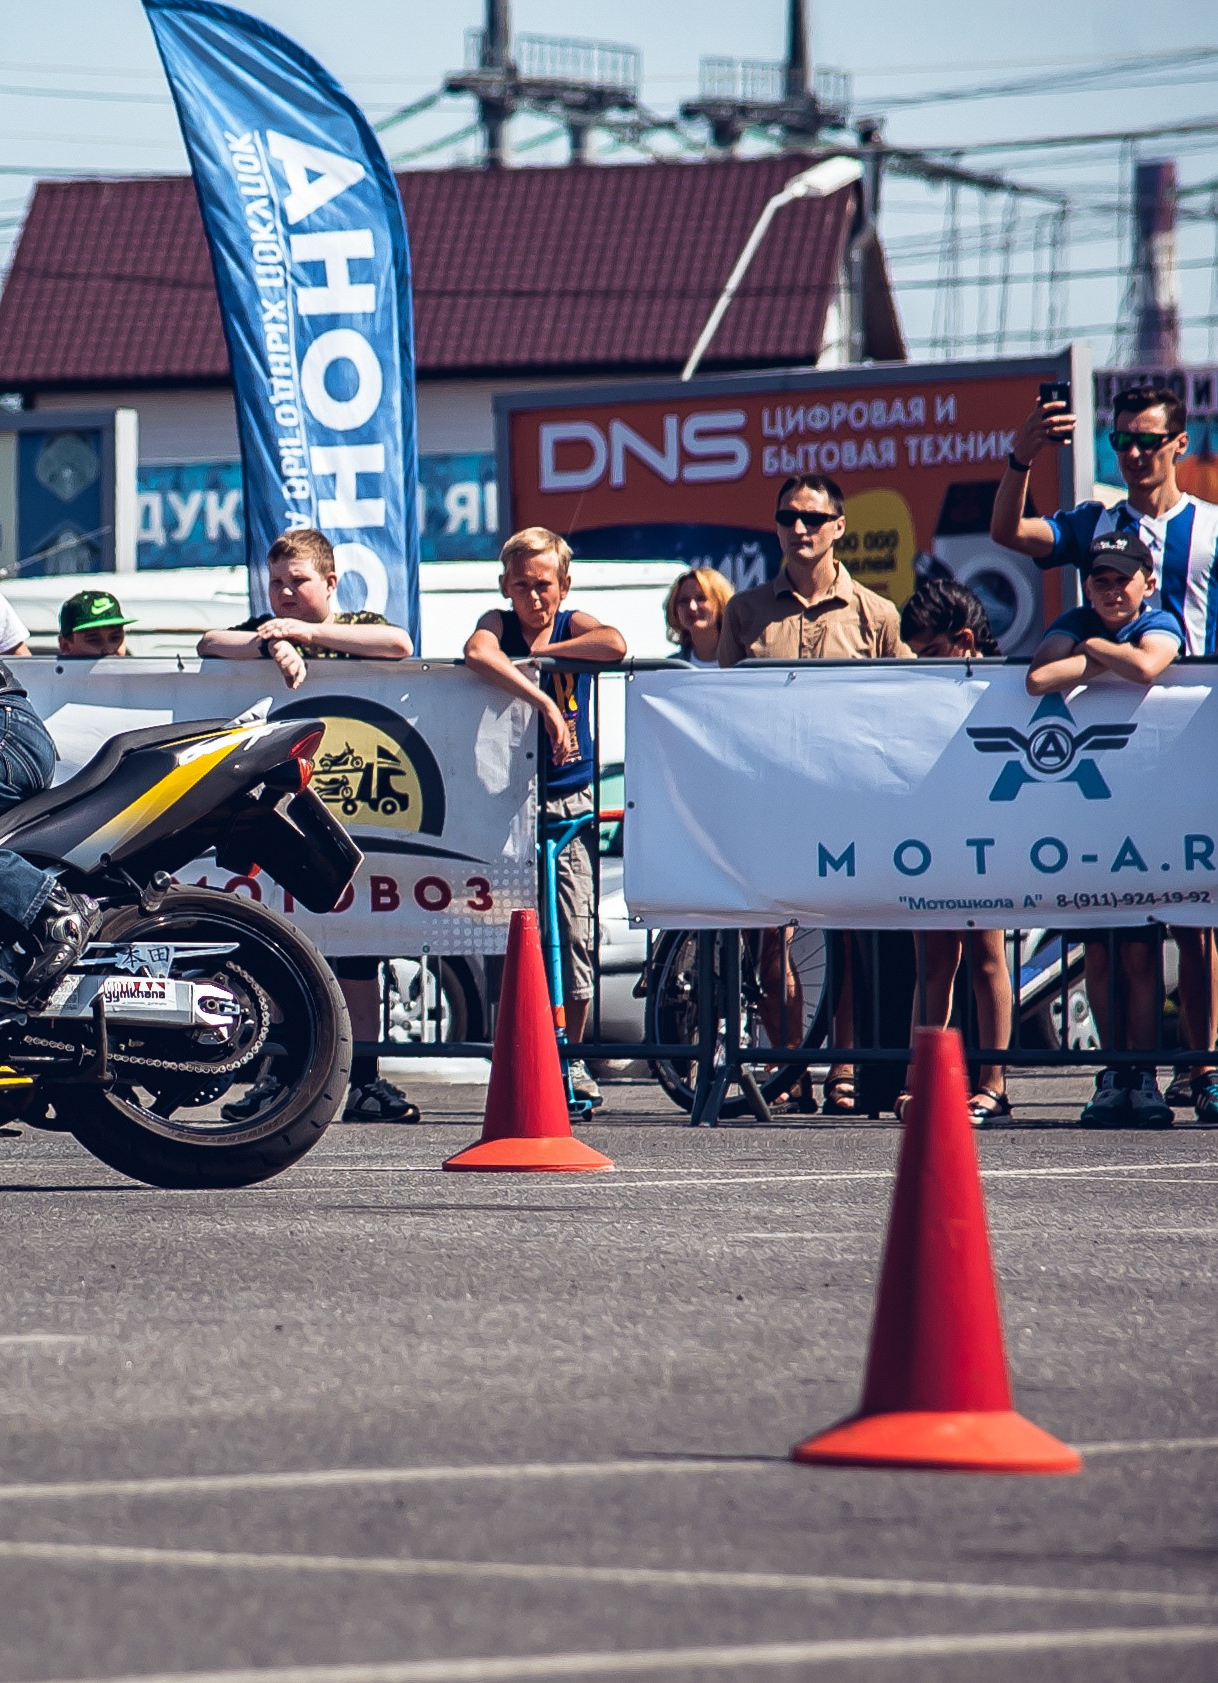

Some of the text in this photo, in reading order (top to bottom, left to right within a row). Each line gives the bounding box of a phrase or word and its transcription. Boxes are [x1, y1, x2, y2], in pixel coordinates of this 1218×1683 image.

[762, 393, 957, 440] ЦИФРОВАЯ И
[539, 410, 750, 493] DNS
[762, 430, 1017, 475] БЫТОВАЯ ТЕХНИК
[818, 834, 1217, 877] MOTO-A.R
[899, 894, 1015, 911] "Мотошкола
[1056, 890, 1211, 910] 8-(911)-924-19-92
[120, 947, 170, 968] 本田
[105, 989, 166, 1003] gymkhana
